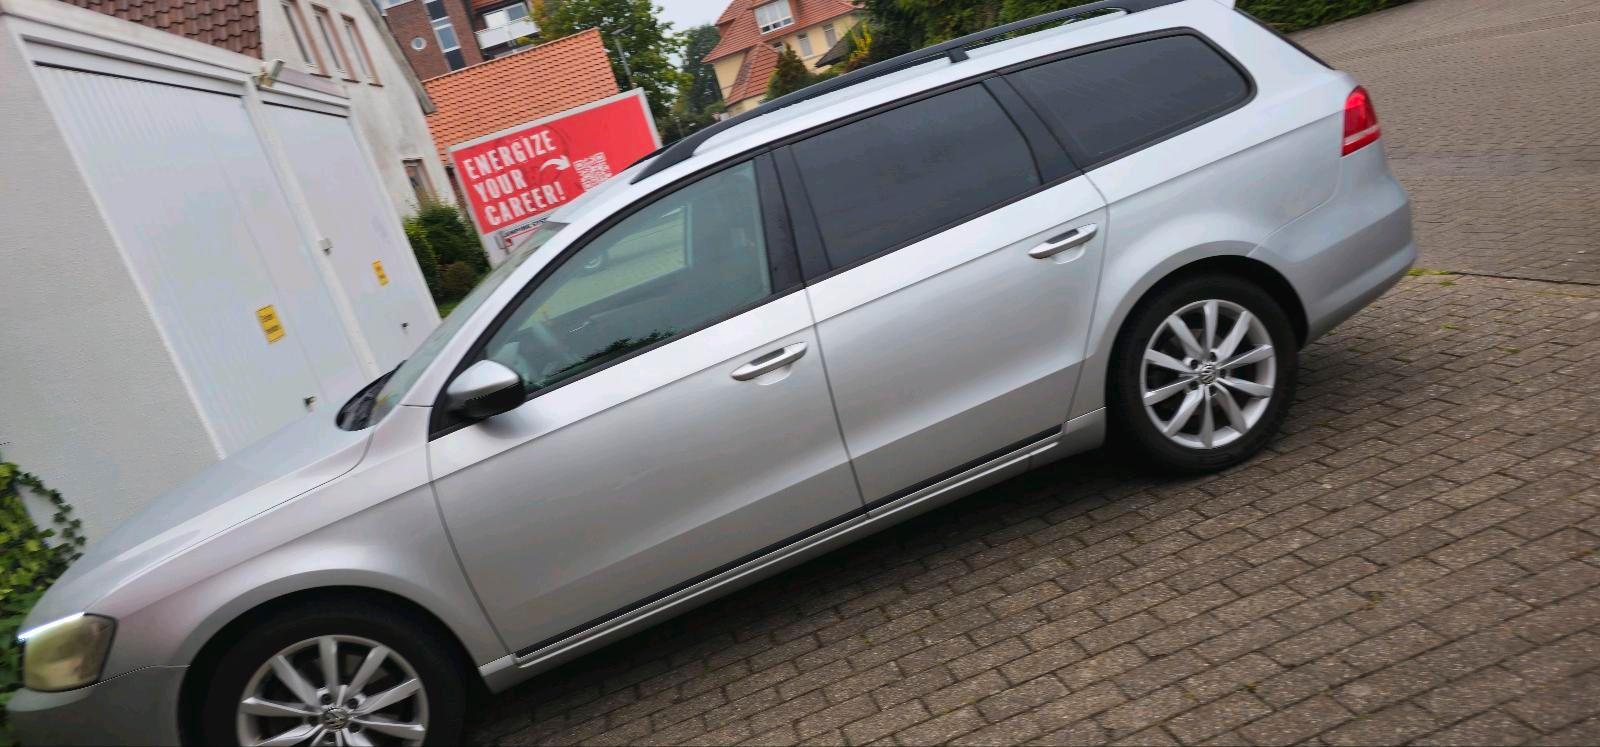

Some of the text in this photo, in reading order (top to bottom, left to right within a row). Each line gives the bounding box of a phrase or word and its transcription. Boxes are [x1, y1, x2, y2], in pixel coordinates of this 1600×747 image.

[463, 130, 557, 180] ENERGIZE
[473, 169, 528, 203] YOUR
[484, 181, 566, 226] CAREER!
